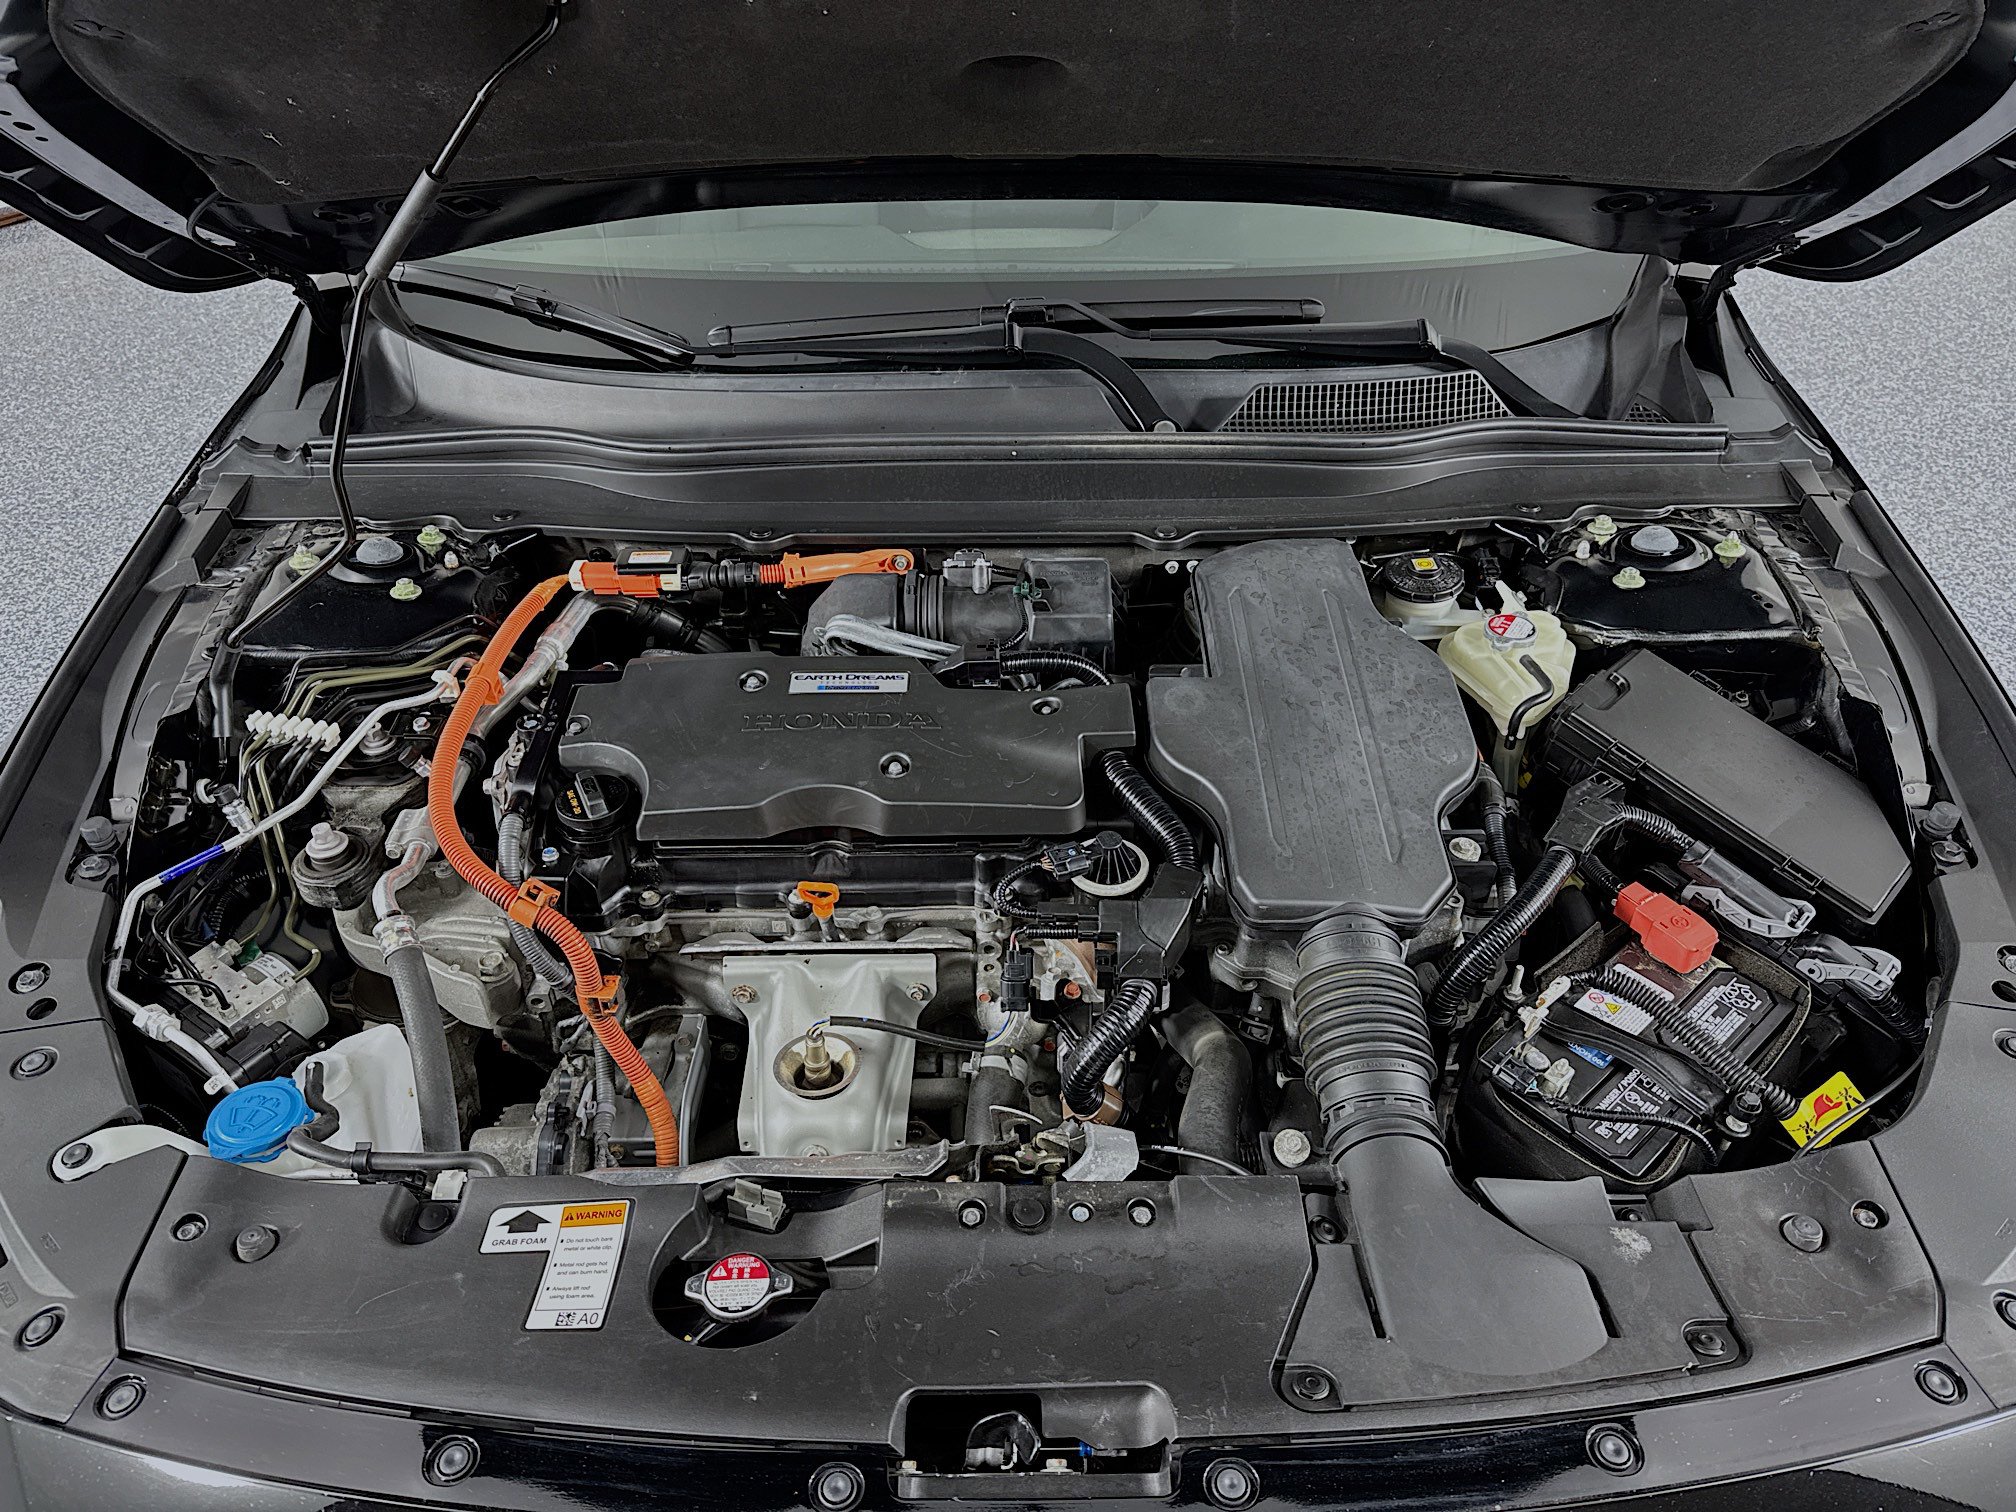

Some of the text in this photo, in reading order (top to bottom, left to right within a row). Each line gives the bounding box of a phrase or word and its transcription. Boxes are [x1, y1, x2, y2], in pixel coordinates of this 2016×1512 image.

[846, 673, 905, 681] DREAMS
[741, 712, 942, 732] HONDA
[1568, 1041, 1592, 1059] MONT
[1620, 1068, 1640, 1087] POISO
[575, 1209, 623, 1220] WARNING
[491, 1237, 548, 1247] GRAB FOAM
